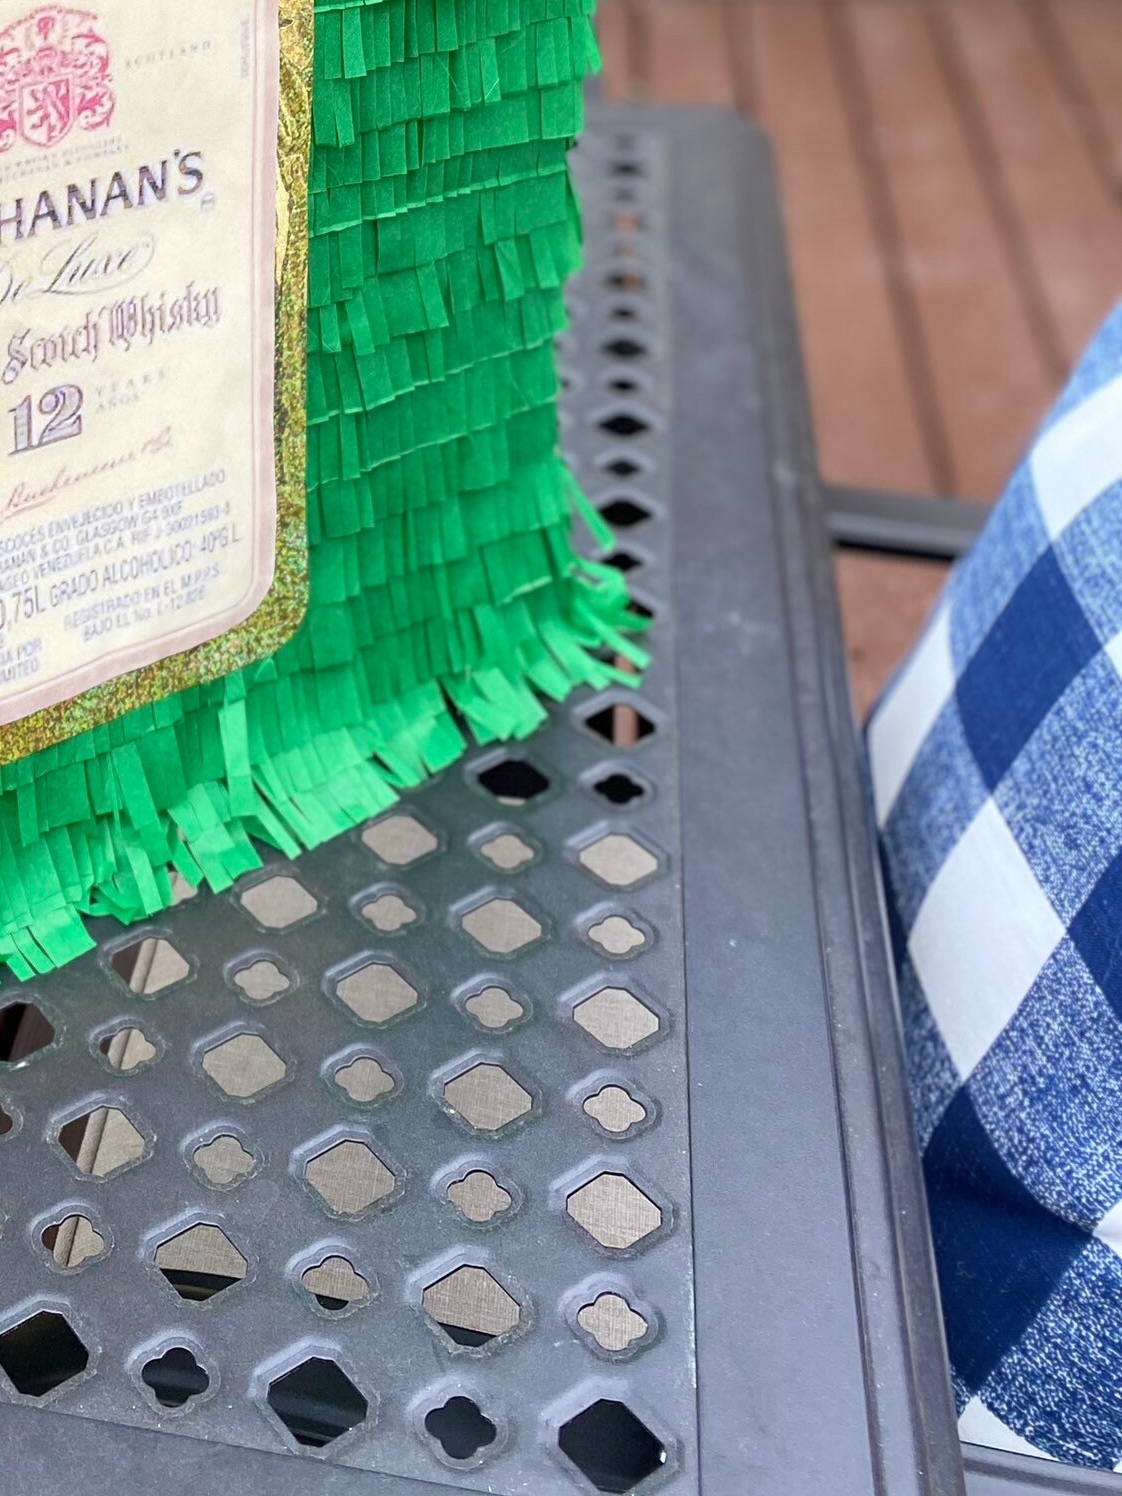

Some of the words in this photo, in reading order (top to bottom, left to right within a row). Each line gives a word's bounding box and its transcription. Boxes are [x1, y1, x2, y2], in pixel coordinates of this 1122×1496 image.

[31, 231, 155, 295] Luxe
[0, 309, 101, 385] Scotch
[101, 280, 222, 353] Whisky
[8, 384, 83, 455] 12
[128, 497, 136, 511] Y
[140, 469, 225, 509] EMBOTELLADO
[40, 543, 49, 558] &
[77, 514, 138, 546] GLASGOW
[50, 569, 99, 608] GRADO
[64, 591, 142, 632] REGISTRADO
[144, 585, 161, 602] EN
[164, 581, 177, 597] EL
[83, 617, 113, 643] BAJO
[116, 612, 131, 629] EL
